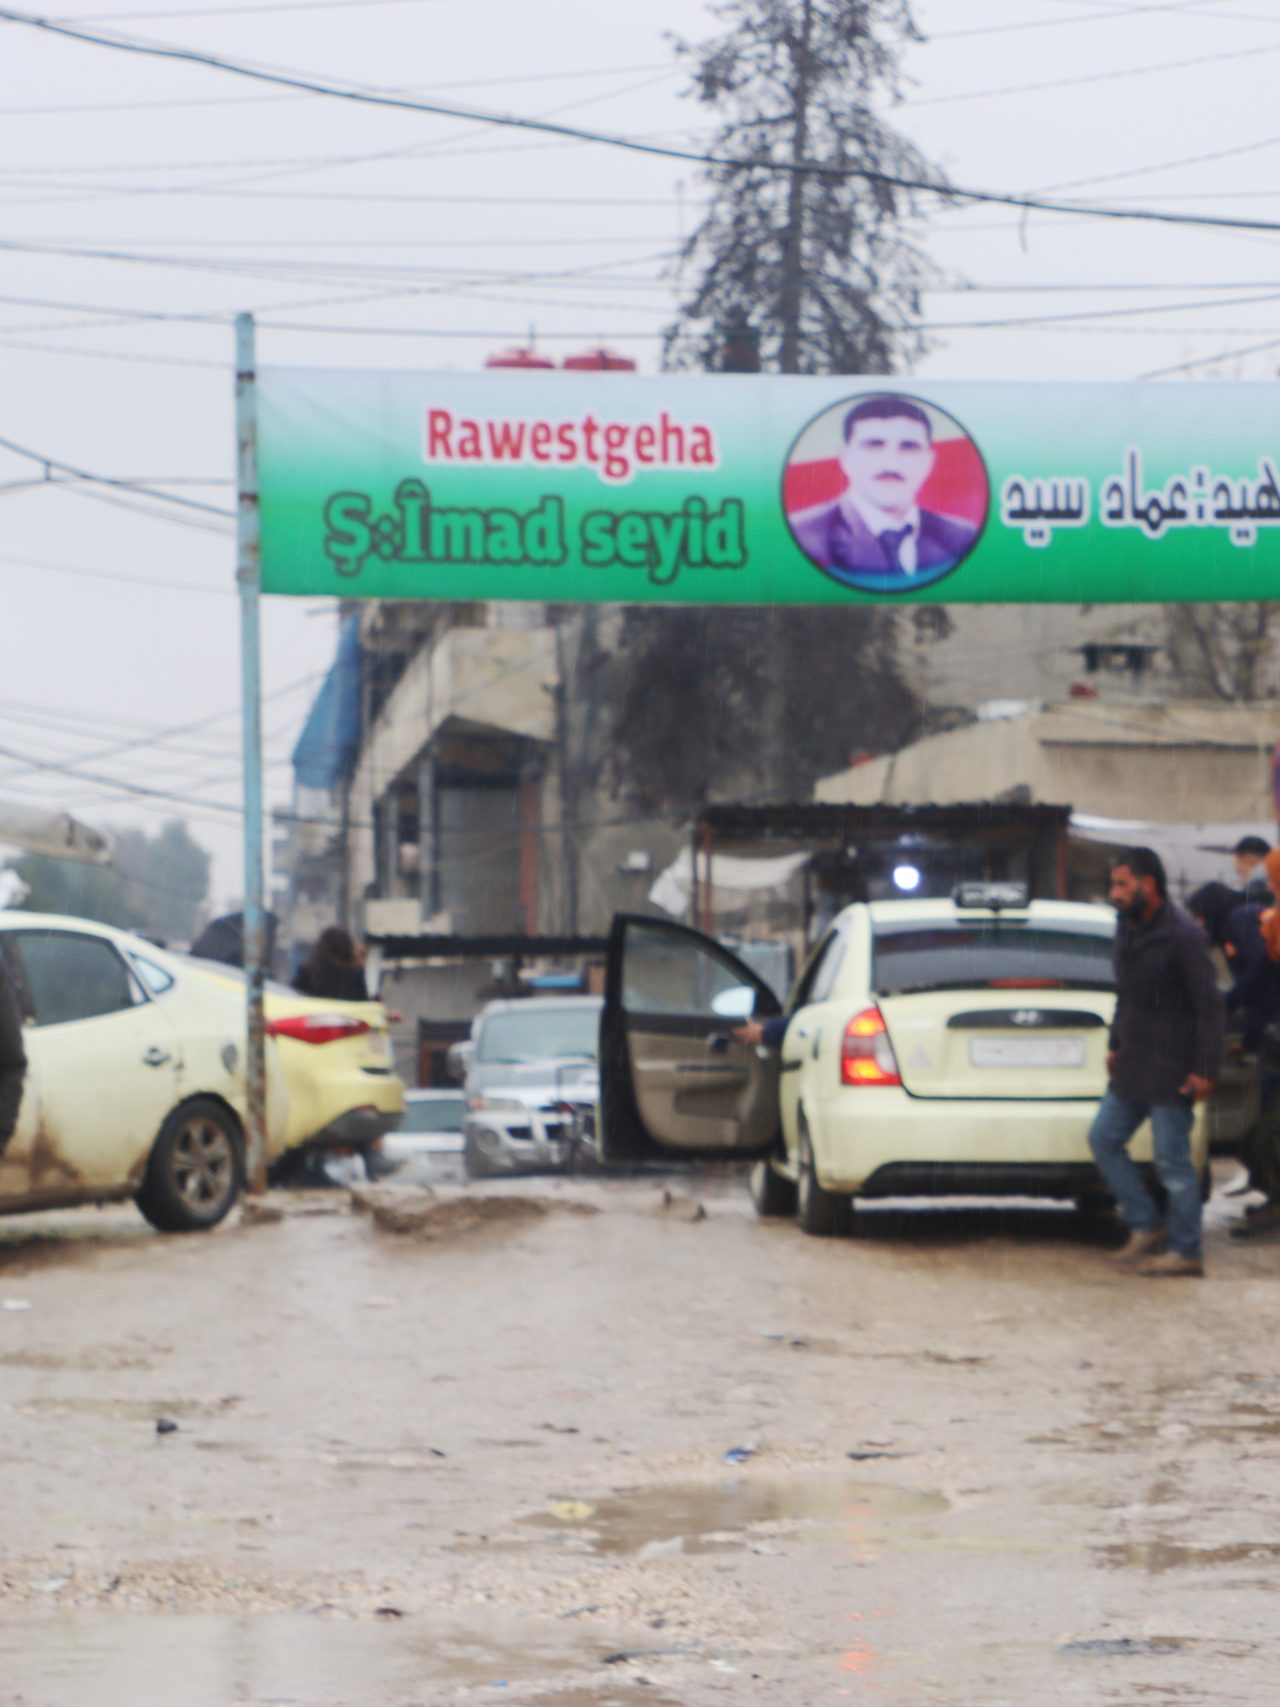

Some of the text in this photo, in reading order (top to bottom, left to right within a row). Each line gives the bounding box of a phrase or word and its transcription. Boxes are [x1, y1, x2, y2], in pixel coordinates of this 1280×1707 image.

[426, 408, 716, 480] Rawestgeha
[579, 495, 748, 586] seyid
[1004, 474, 1088, 544] سيد
